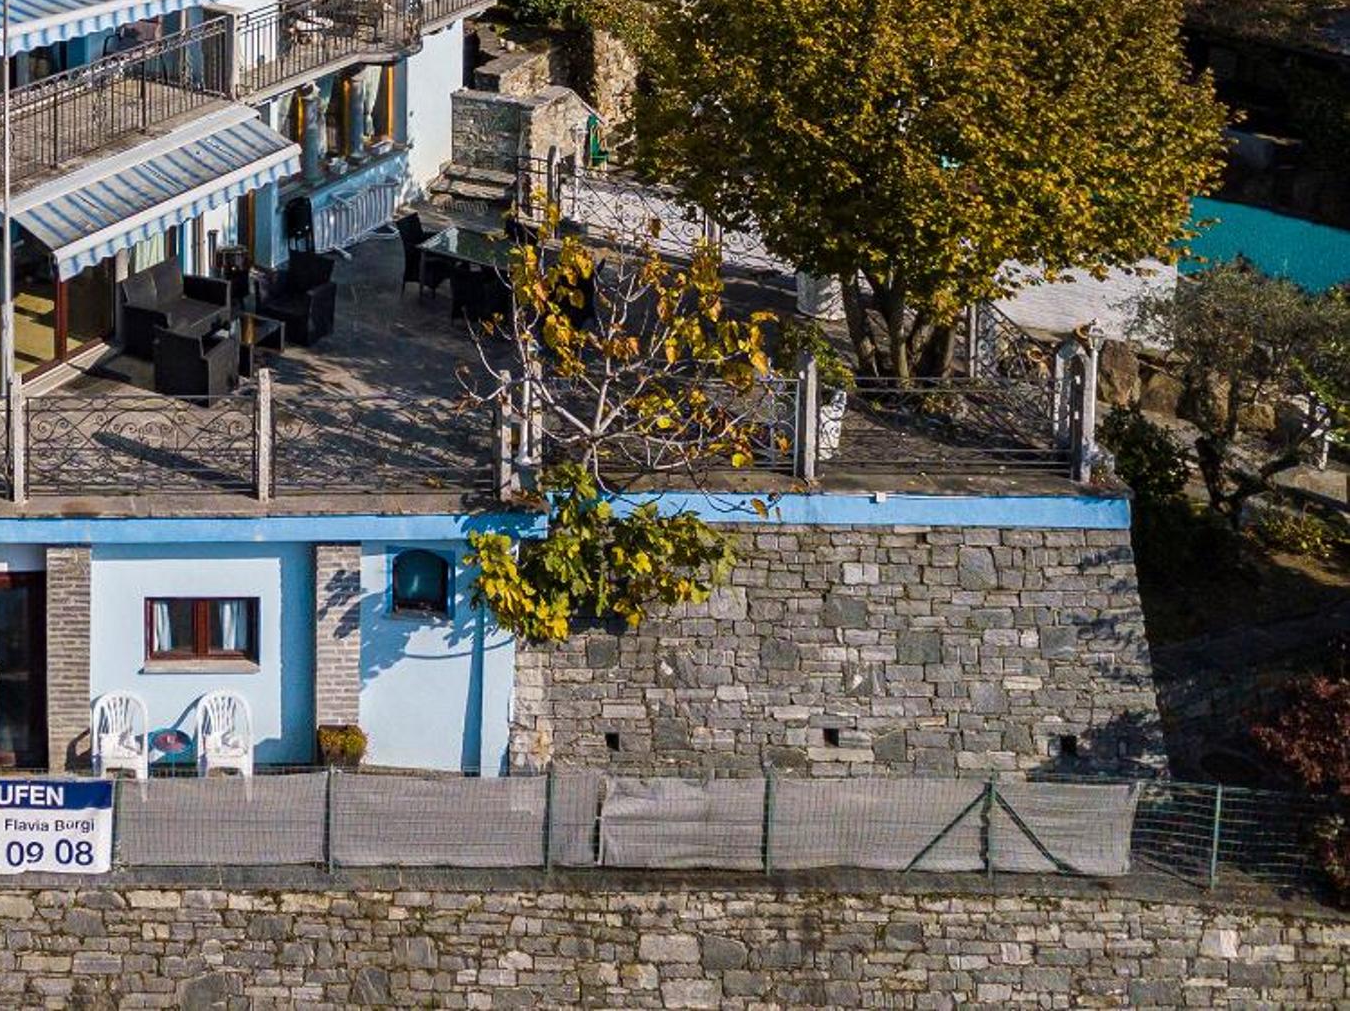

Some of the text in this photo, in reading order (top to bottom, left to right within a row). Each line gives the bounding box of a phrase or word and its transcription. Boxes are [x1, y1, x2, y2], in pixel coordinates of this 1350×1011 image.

[4, 818, 50, 832] Flavia
[6, 841, 44, 866] 09
[55, 839, 94, 866] 08
